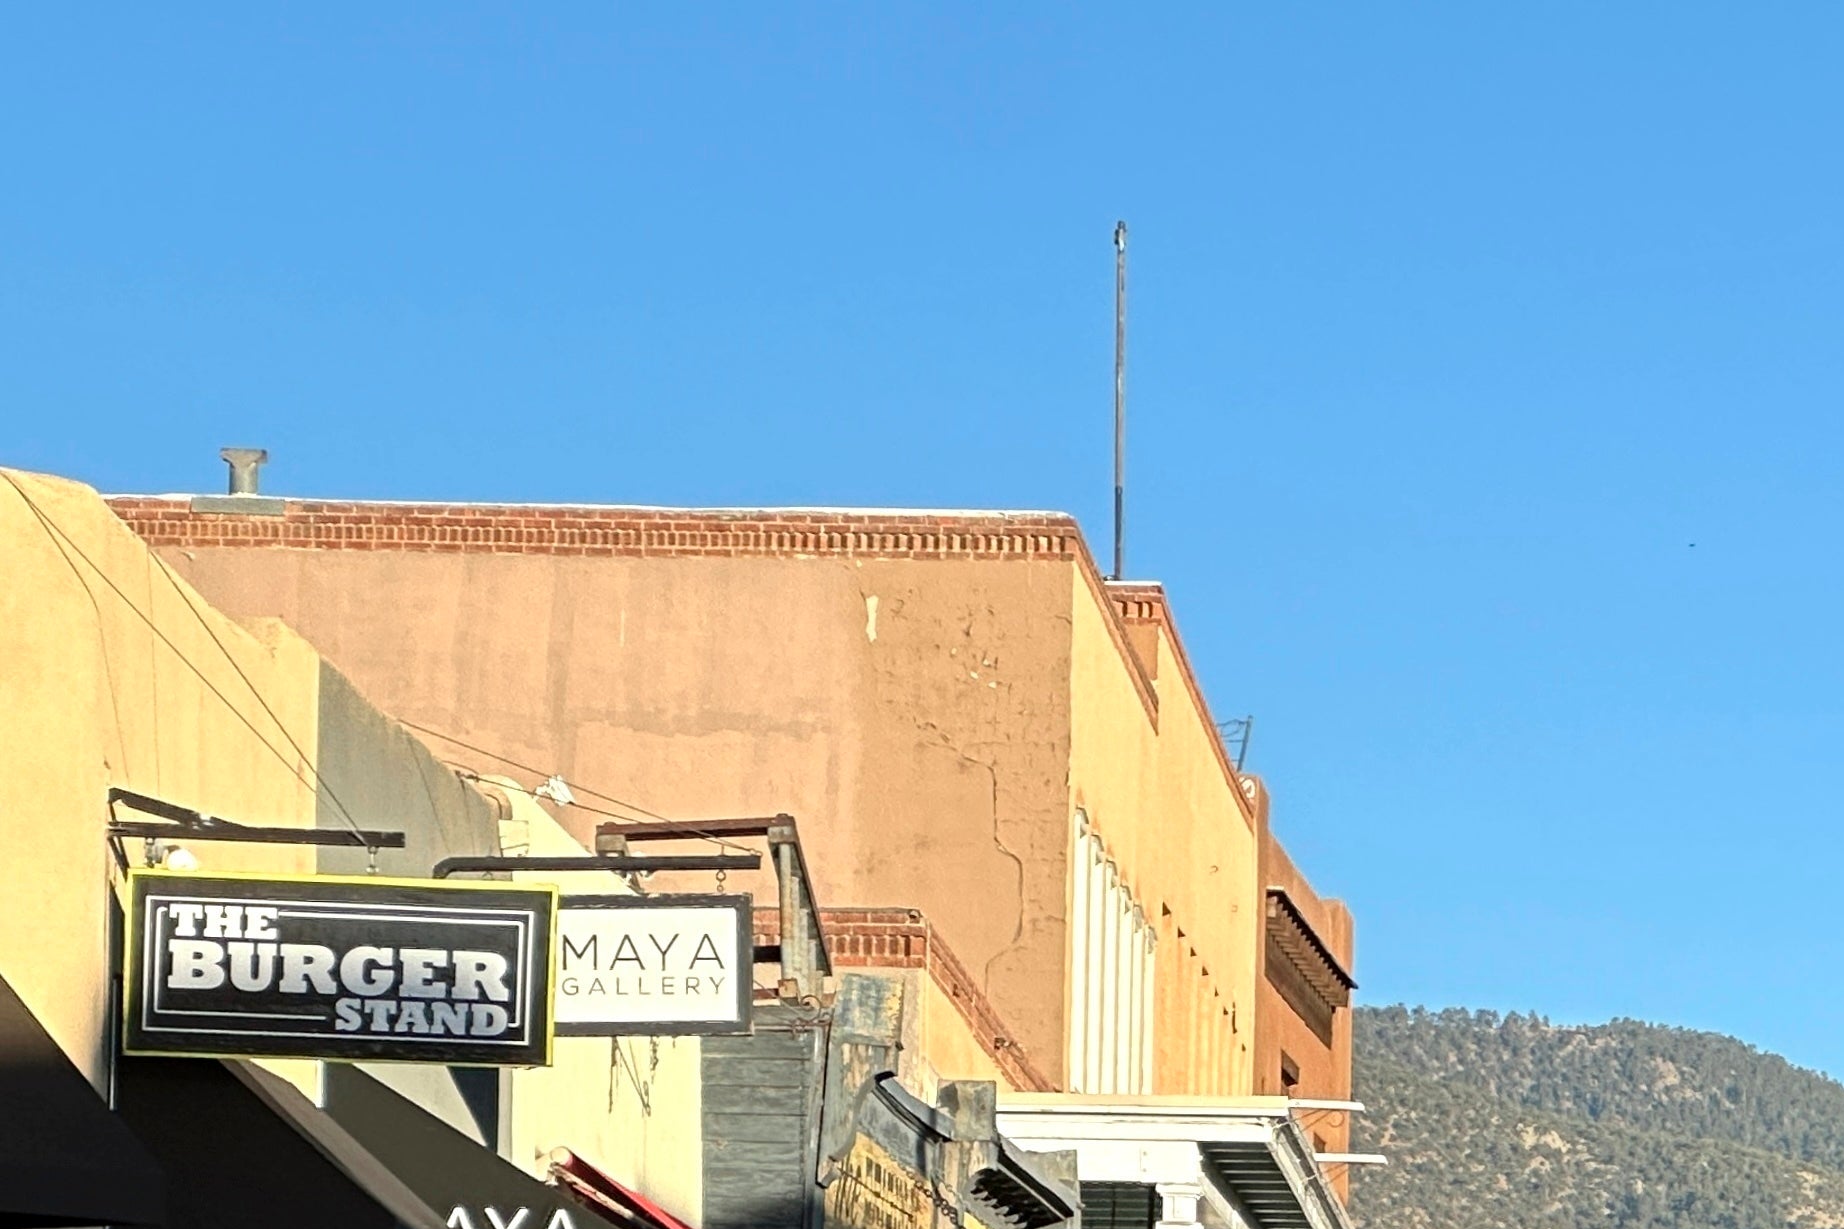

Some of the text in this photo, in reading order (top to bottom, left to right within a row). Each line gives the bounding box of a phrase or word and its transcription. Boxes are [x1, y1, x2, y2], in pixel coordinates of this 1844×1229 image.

[168, 903, 278, 939] THE
[167, 938, 509, 1002] BURGER
[562, 933, 726, 971] MAYA
[561, 976, 726, 996] GALLERY
[334, 997, 508, 1037] STAND
